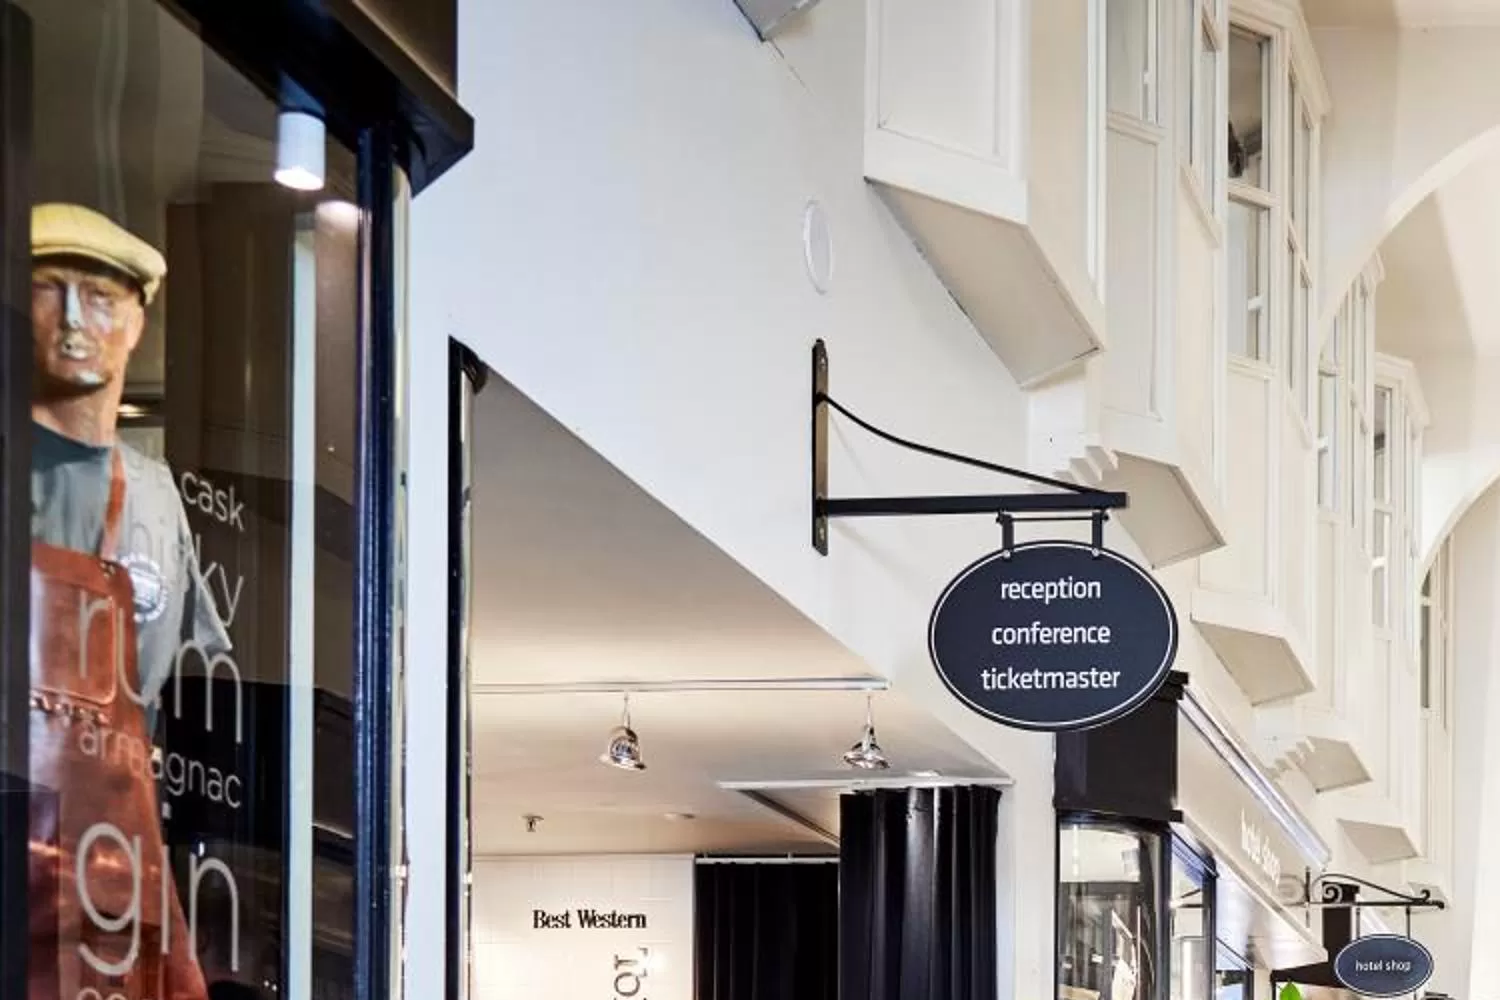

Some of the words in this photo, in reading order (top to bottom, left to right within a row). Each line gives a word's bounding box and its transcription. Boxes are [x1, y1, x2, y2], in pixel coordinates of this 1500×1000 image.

[180, 470, 245, 532] cask
[1001, 576, 1101, 605] reception
[992, 621, 1111, 645] conference
[79, 589, 244, 744] rum
[981, 667, 1121, 690] ticketmaster
[75, 801, 240, 977] gin
[533, 909, 571, 929] Best
[576, 909, 647, 929] Western
[1355, 959, 1383, 972] hotel
[1385, 959, 1411, 973] shop
